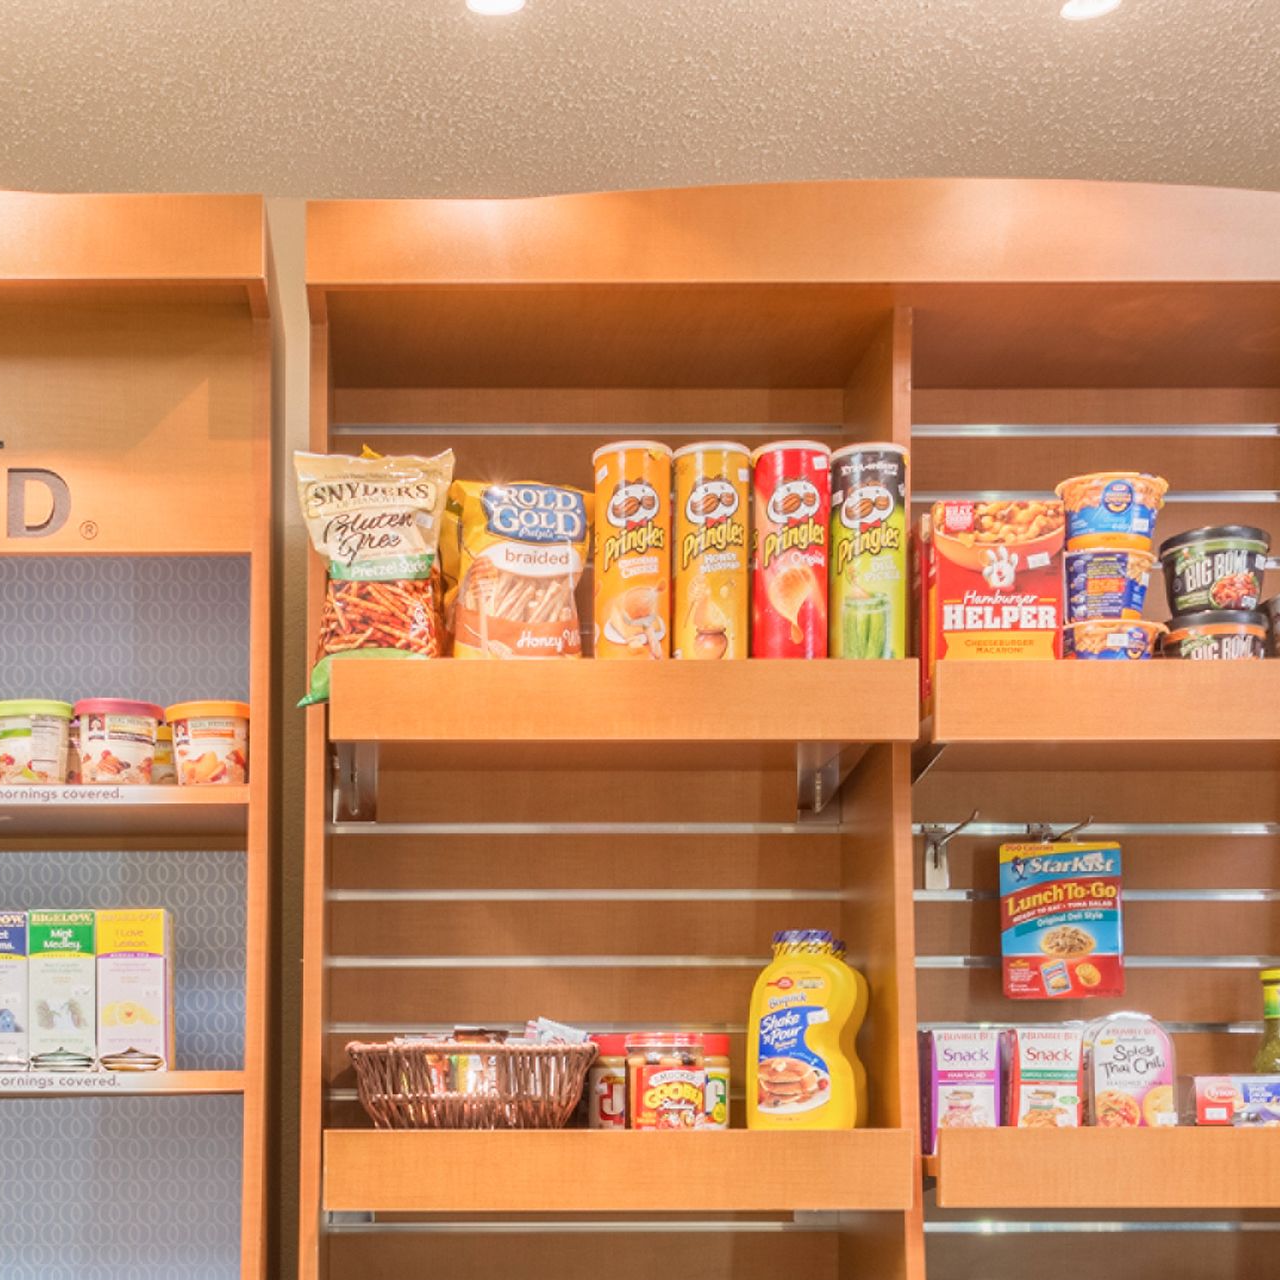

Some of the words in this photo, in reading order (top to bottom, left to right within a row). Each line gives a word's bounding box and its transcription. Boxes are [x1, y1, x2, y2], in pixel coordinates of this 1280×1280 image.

[503, 487, 580, 511] ROLD
[324, 512, 413, 544] Gluten
[492, 505, 582, 537] GOLD
[604, 520, 665, 572] Pringles
[683, 520, 744, 570] Pringles
[763, 519, 824, 569] Pringles
[837, 526, 900, 574] Pringles
[505, 548, 570, 565] braided
[351, 560, 396, 577] Pretzel
[1185, 557, 1212, 592] BIG
[964, 590, 1038, 608] Hamburger
[943, 604, 1056, 630] HELPER
[517, 629, 563, 652] Honey
[62, 787, 124, 800] covered.
[1029, 856, 1115, 874] StarKist
[1007, 884, 1064, 917] Lunch
[31, 912, 93, 924] BIGELOW
[1037, 914, 1066, 927] Original
[1068, 911, 1082, 921] Deli
[1084, 911, 1104, 922] Style
[50, 928, 74, 940] Mint
[761, 1010, 801, 1035] Shake
[771, 1025, 803, 1046] Pour
[943, 1047, 990, 1062] Snack
[1026, 1047, 1073, 1062] Snack
[1113, 1044, 1155, 1062] Spicy
[1099, 1062, 1131, 1079] Thai
[1133, 1057, 1166, 1074] Chili
[59, 1073, 120, 1088] covered.
